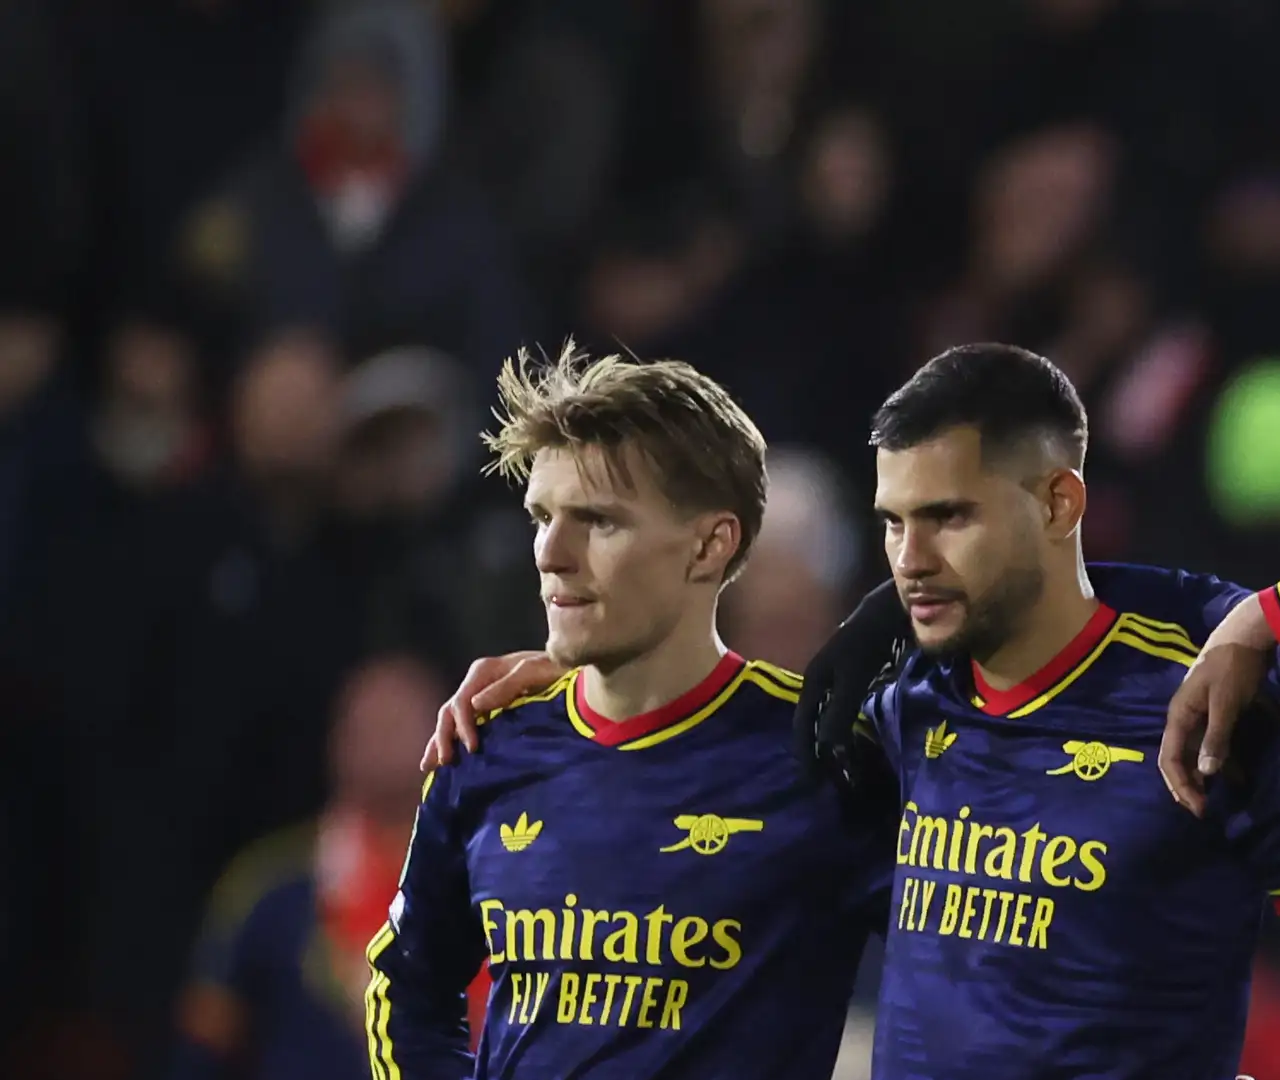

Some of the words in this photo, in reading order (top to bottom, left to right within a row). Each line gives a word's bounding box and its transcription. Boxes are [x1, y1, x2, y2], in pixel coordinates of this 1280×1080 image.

[896, 801, 1108, 893] Emirates
[480, 895, 743, 975] Emirates
[899, 877, 938, 931] FLY
[938, 879, 1056, 950] BETTER
[509, 973, 551, 1025] FLY
[556, 971, 690, 1031] BETTER
